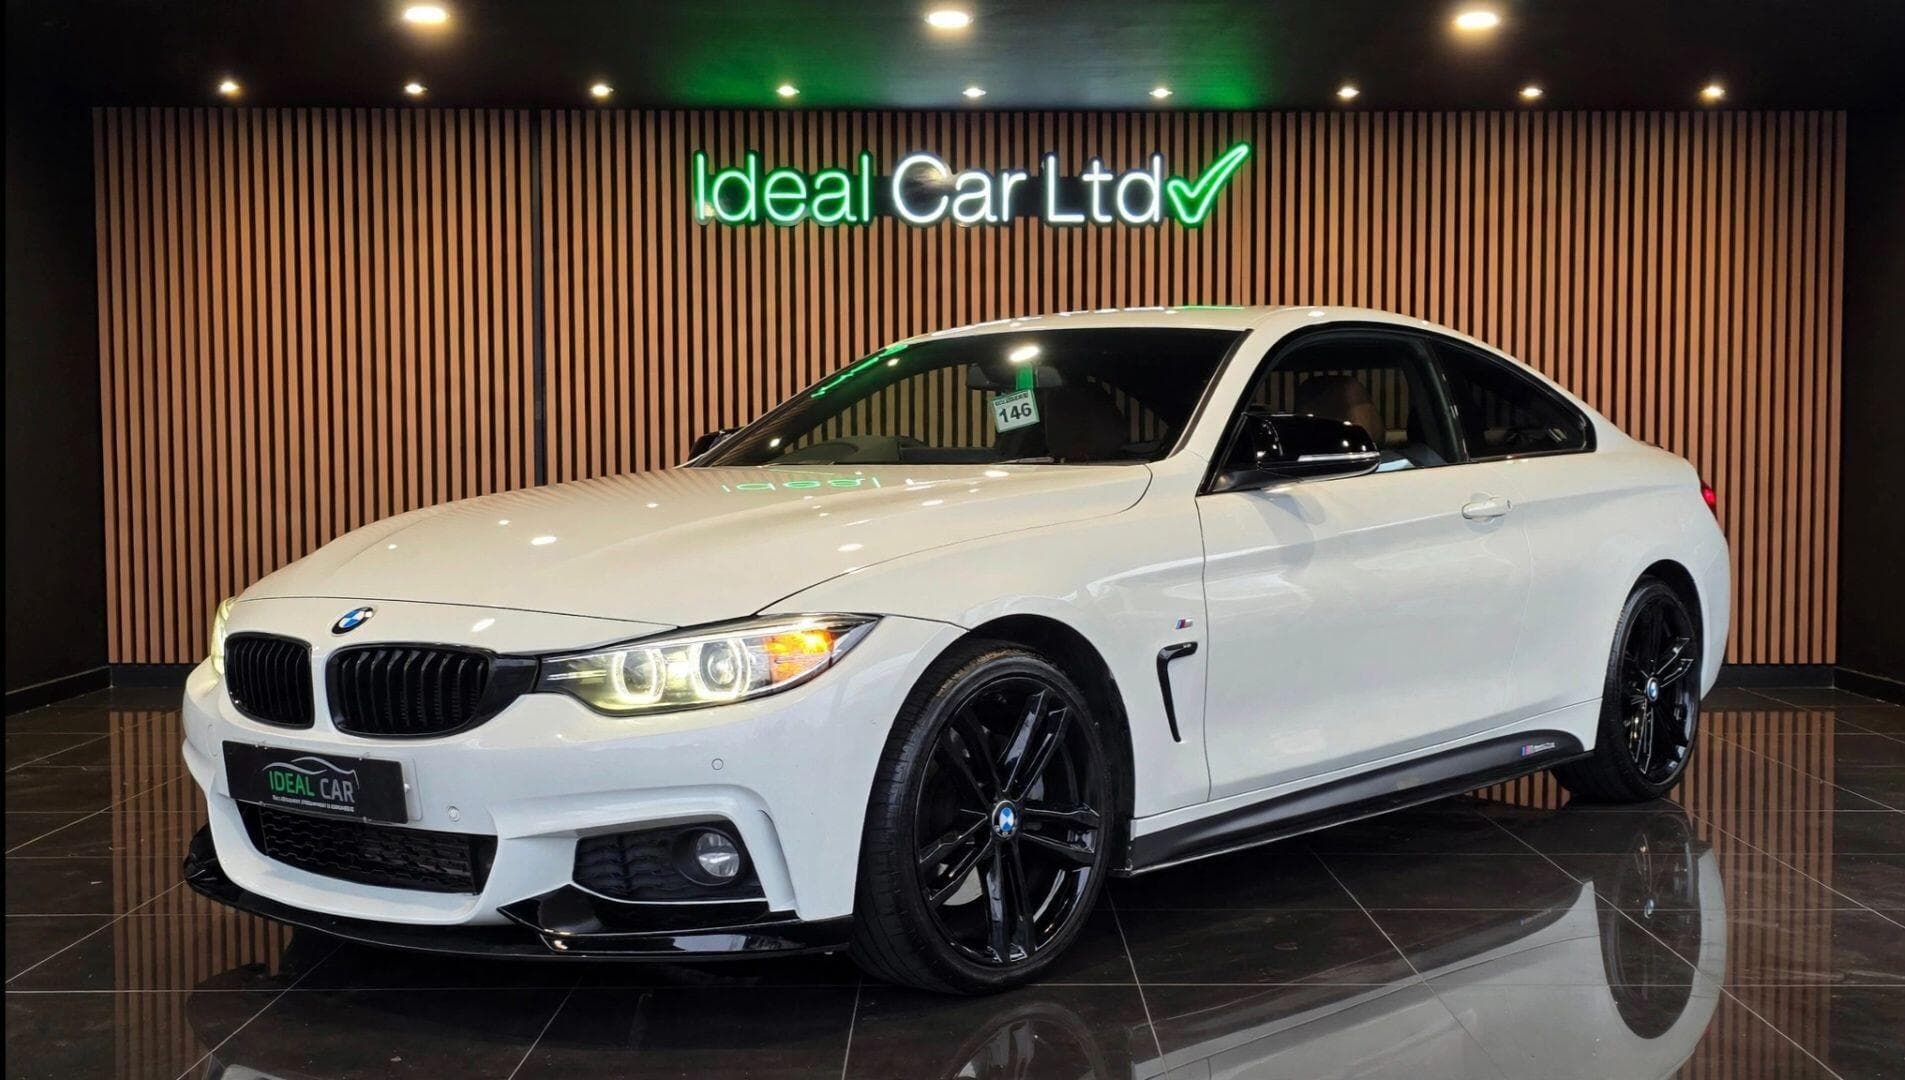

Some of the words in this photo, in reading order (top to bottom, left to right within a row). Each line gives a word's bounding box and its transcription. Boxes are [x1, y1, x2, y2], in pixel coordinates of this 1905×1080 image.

[694, 150, 871, 224] Ideal
[890, 153, 1027, 224] Car
[1046, 153, 1163, 224] Ltd
[998, 402, 1033, 423] 146
[268, 770, 316, 797] IDEAL
[319, 778, 356, 803] CAR
